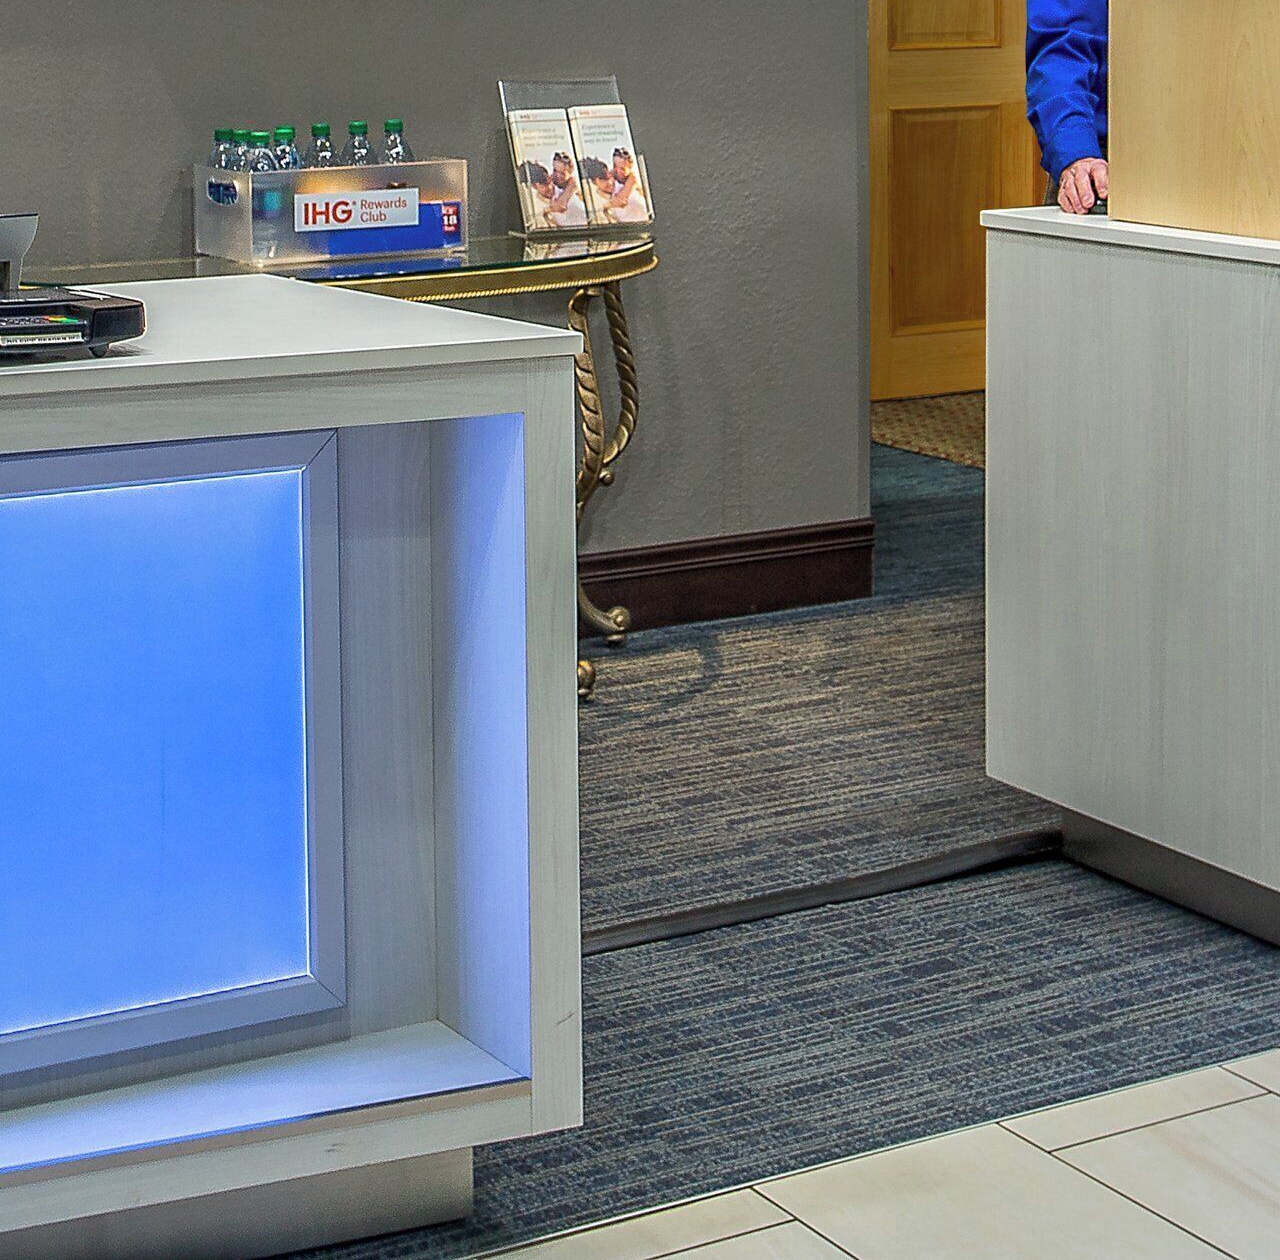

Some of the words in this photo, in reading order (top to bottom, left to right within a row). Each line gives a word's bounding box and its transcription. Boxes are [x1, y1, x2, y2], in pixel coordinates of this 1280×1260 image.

[303, 200, 353, 226] IHG
[360, 197, 408, 210] Rewards
[360, 210, 387, 223] Club
